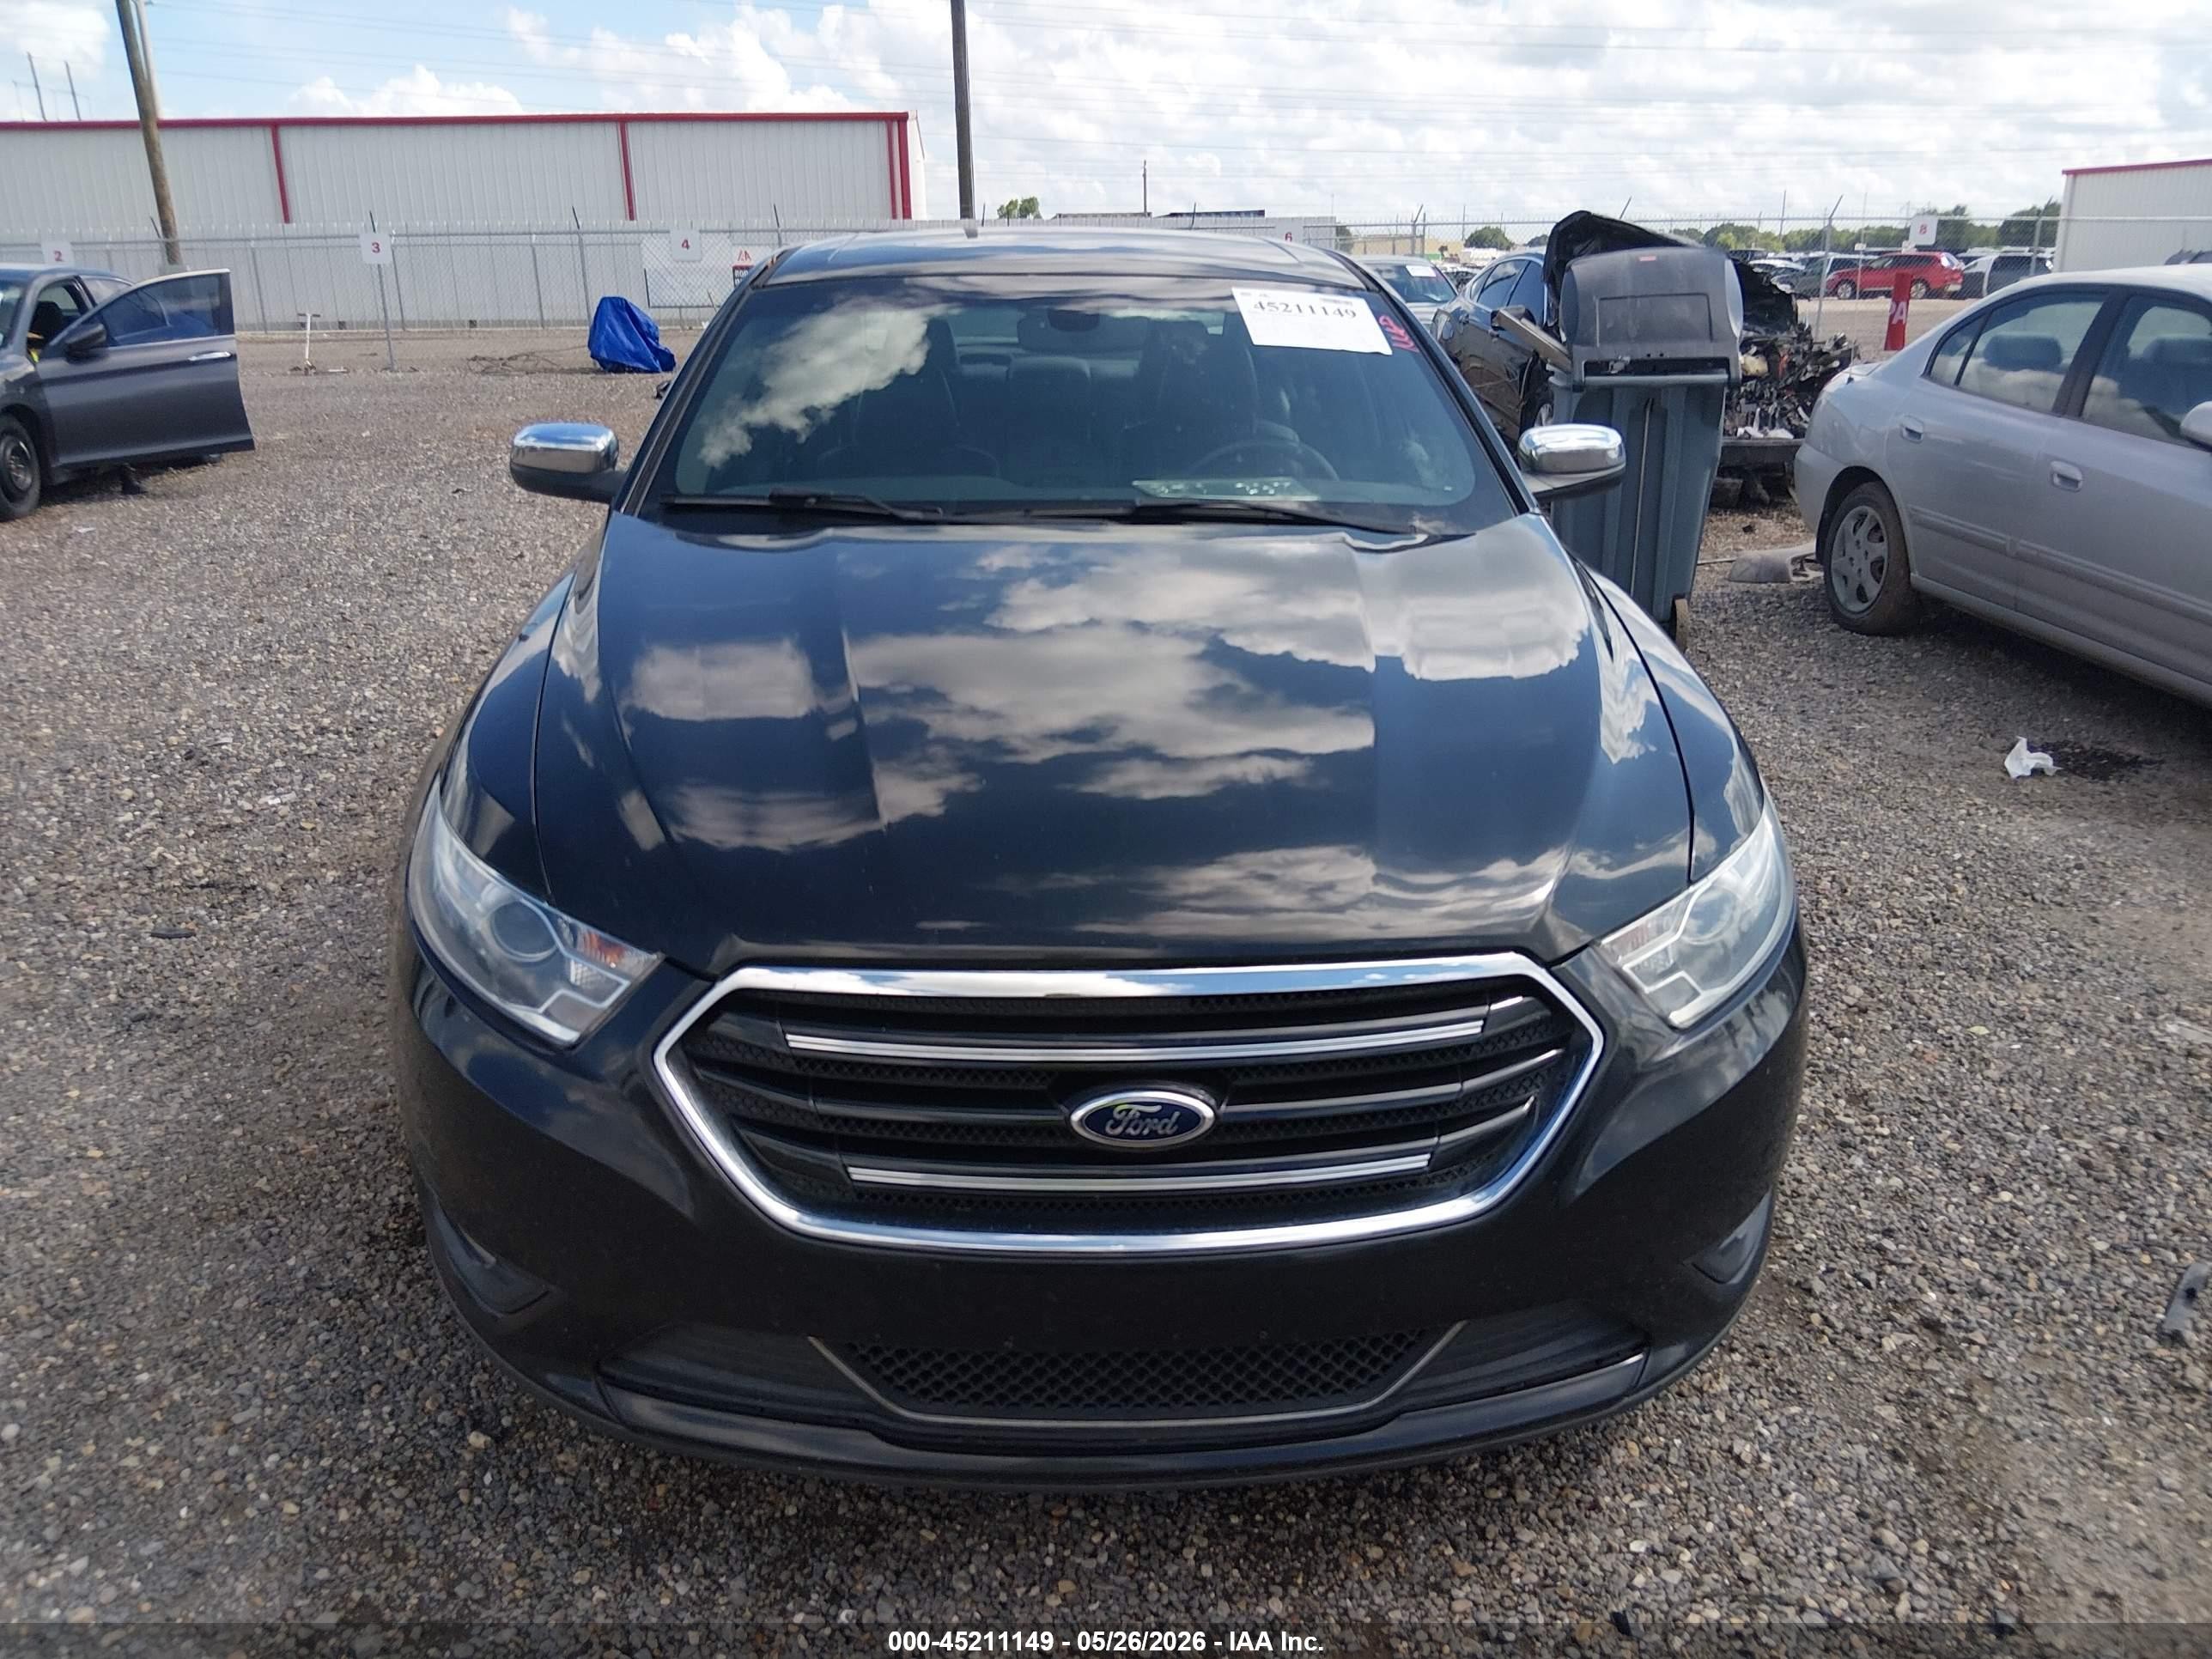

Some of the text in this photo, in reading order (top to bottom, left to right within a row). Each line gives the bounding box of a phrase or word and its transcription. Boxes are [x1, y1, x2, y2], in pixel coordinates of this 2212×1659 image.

[371, 240, 381, 254] 3
[681, 239, 690, 251] 4
[53, 249, 64, 262] 2
[1253, 300, 1358, 319] 45211149
[1104, 1103, 1182, 1136] Ford
